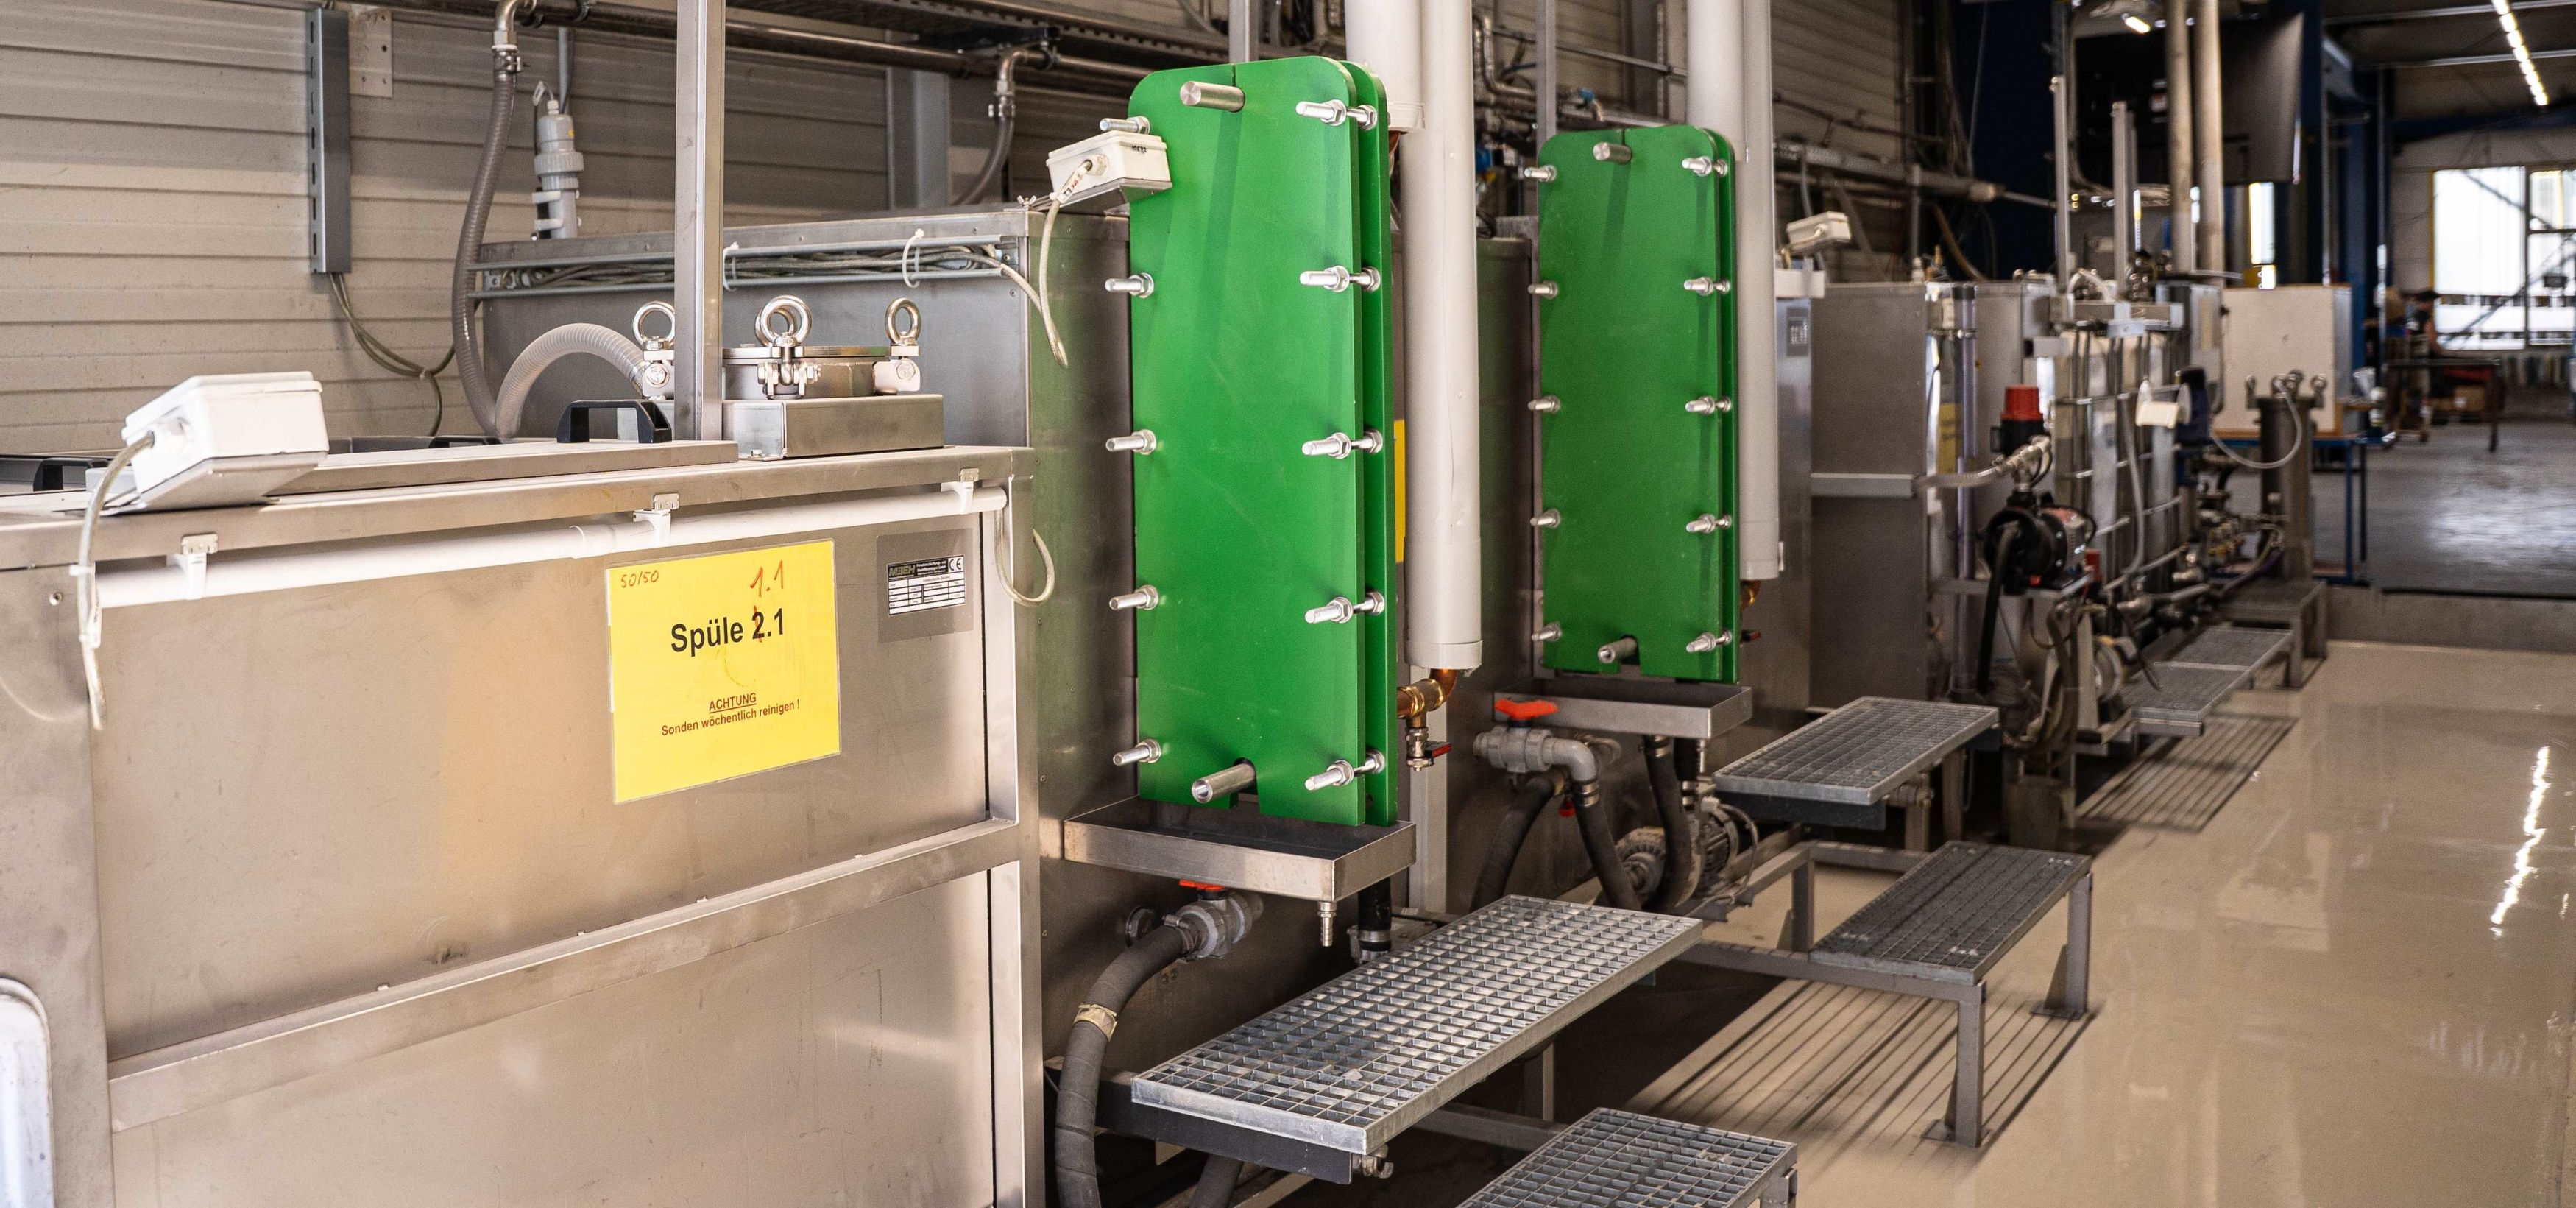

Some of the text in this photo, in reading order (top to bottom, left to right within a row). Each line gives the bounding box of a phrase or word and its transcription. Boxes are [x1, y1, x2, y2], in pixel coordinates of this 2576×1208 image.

[621, 570, 659, 588] 50/50
[750, 559, 784, 597] 1.1
[671, 607, 784, 657] Spüle 2.1
[662, 721, 698, 736] Sonden
[701, 708, 757, 728] wöchentlich
[759, 702, 795, 717] reinigen
[709, 693, 757, 712] ACHTUNG
